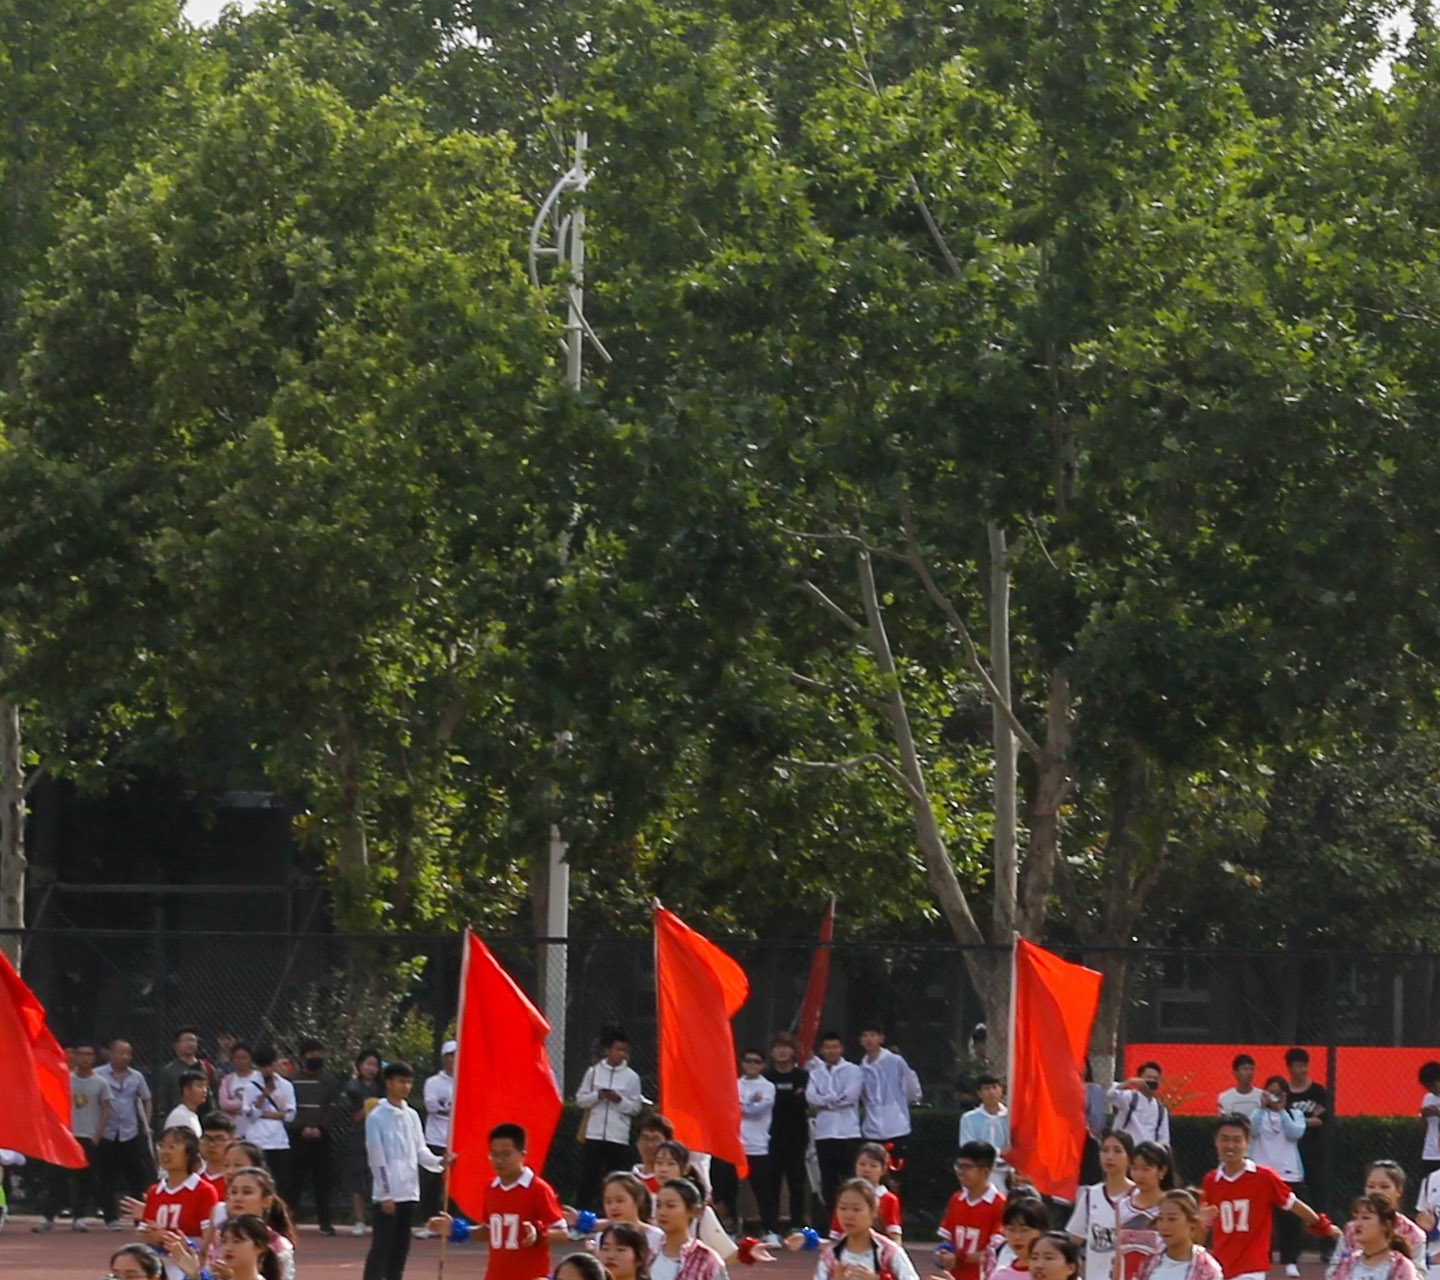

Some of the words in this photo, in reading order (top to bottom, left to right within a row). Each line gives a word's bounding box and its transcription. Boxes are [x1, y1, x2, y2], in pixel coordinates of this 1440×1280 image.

[157, 1204, 182, 1228] 07
[1220, 1200, 1249, 1232] 07
[490, 1214, 520, 1249] 07
[954, 1226, 981, 1253] 07
